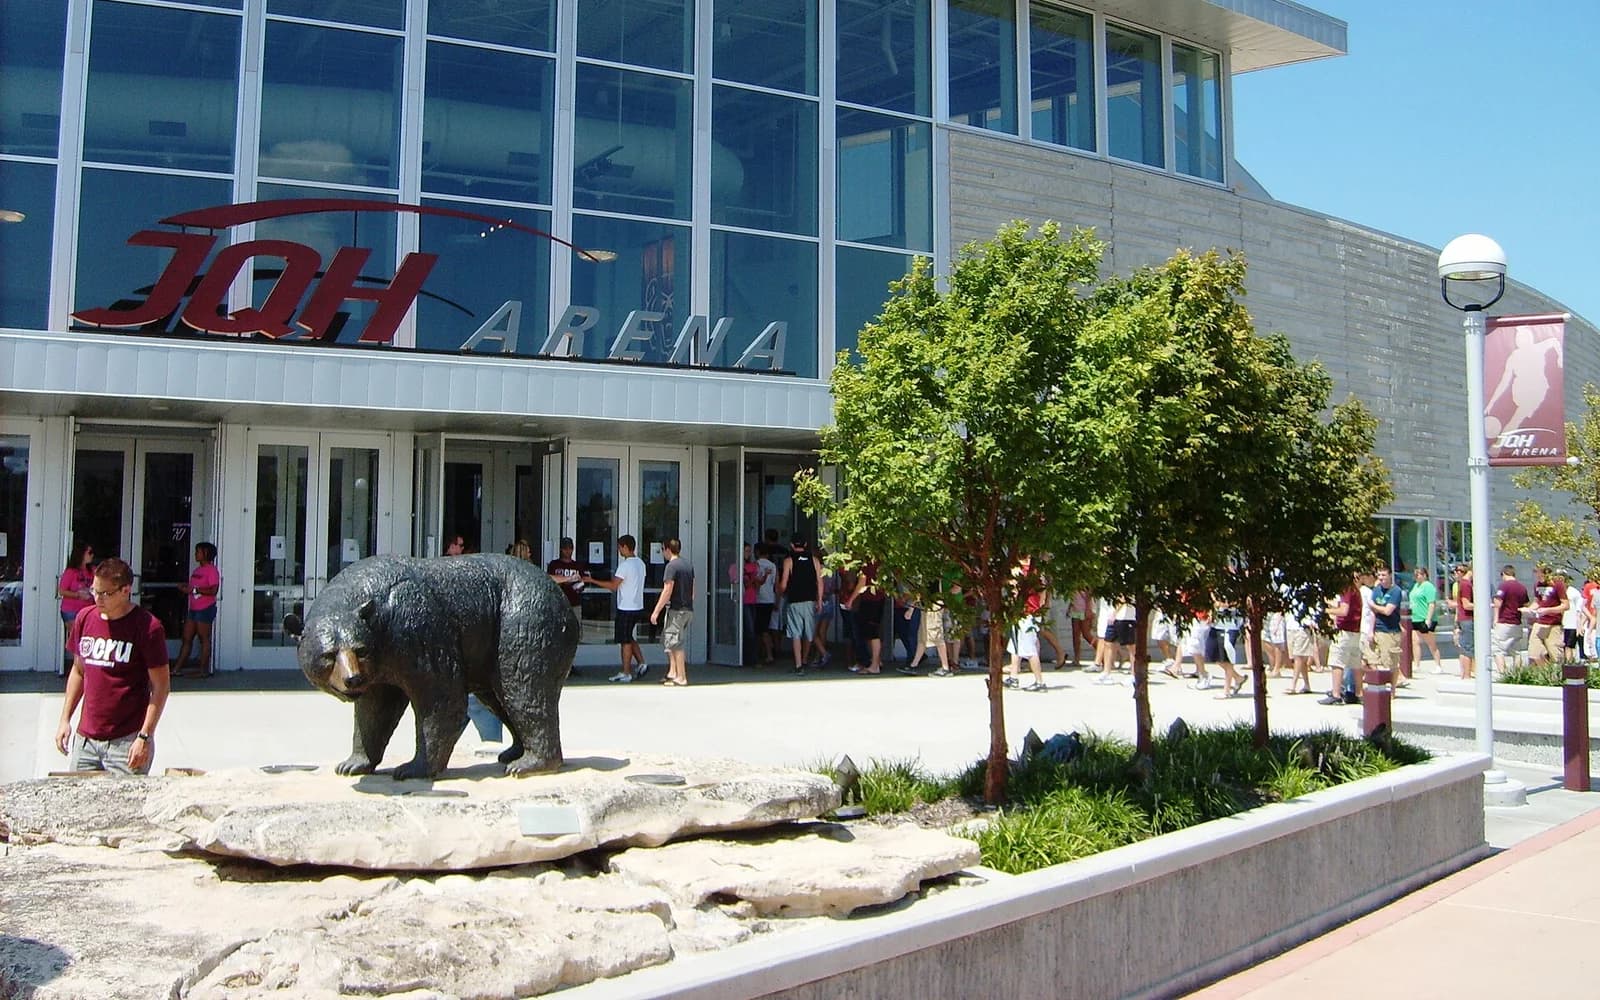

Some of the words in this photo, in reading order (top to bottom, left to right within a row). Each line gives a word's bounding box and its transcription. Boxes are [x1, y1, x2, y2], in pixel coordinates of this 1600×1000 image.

[70, 229, 440, 343] JQH
[459, 299, 789, 371] ARENA
[1492, 434, 1534, 447] JQH
[1511, 447, 1557, 456] ARENA
